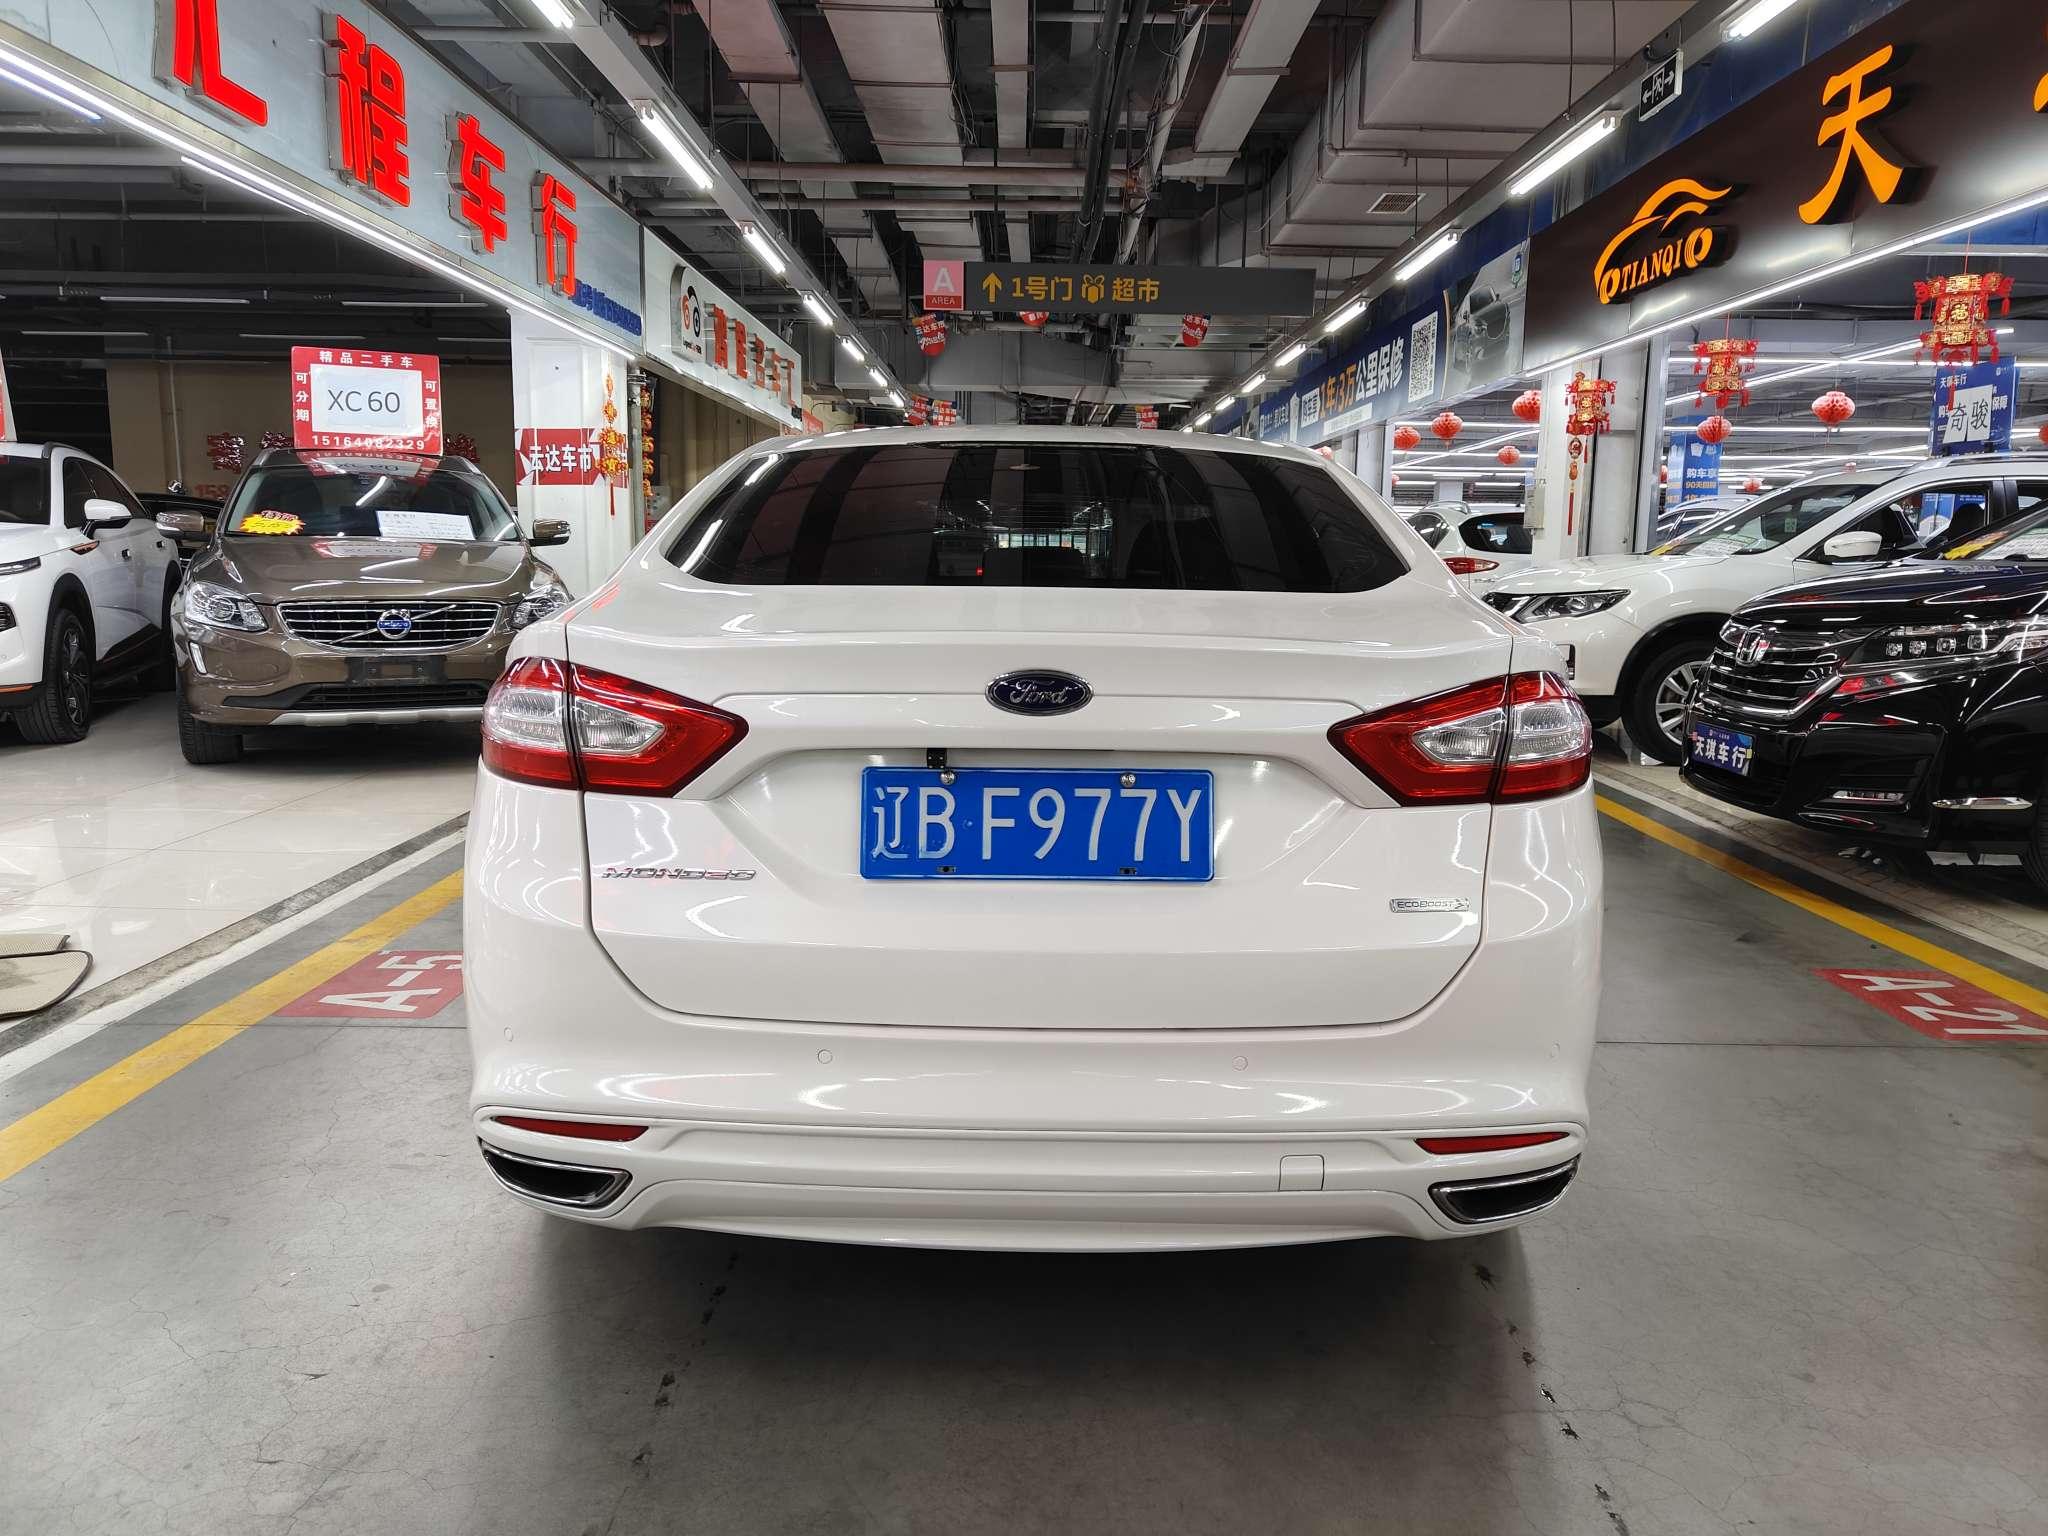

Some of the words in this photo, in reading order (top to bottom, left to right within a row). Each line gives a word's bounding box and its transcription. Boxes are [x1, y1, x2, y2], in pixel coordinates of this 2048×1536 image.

[933, 267, 955, 293] A
[1012, 276, 1073, 301] 1号门
[1112, 277, 1160, 302] 超市
[930, 296, 956, 305] AREA
[319, 350, 413, 368] 精品二手车
[296, 372, 310, 422] 可分期
[424, 380, 440, 430] 可置换
[529, 443, 593, 473] 云达车市
[1009, 680, 1068, 703] Ford
[1695, 736, 1746, 769] 天琪车行
[601, 867, 757, 880] MONDEO
[1839, 973, 2048, 1036] A-21
